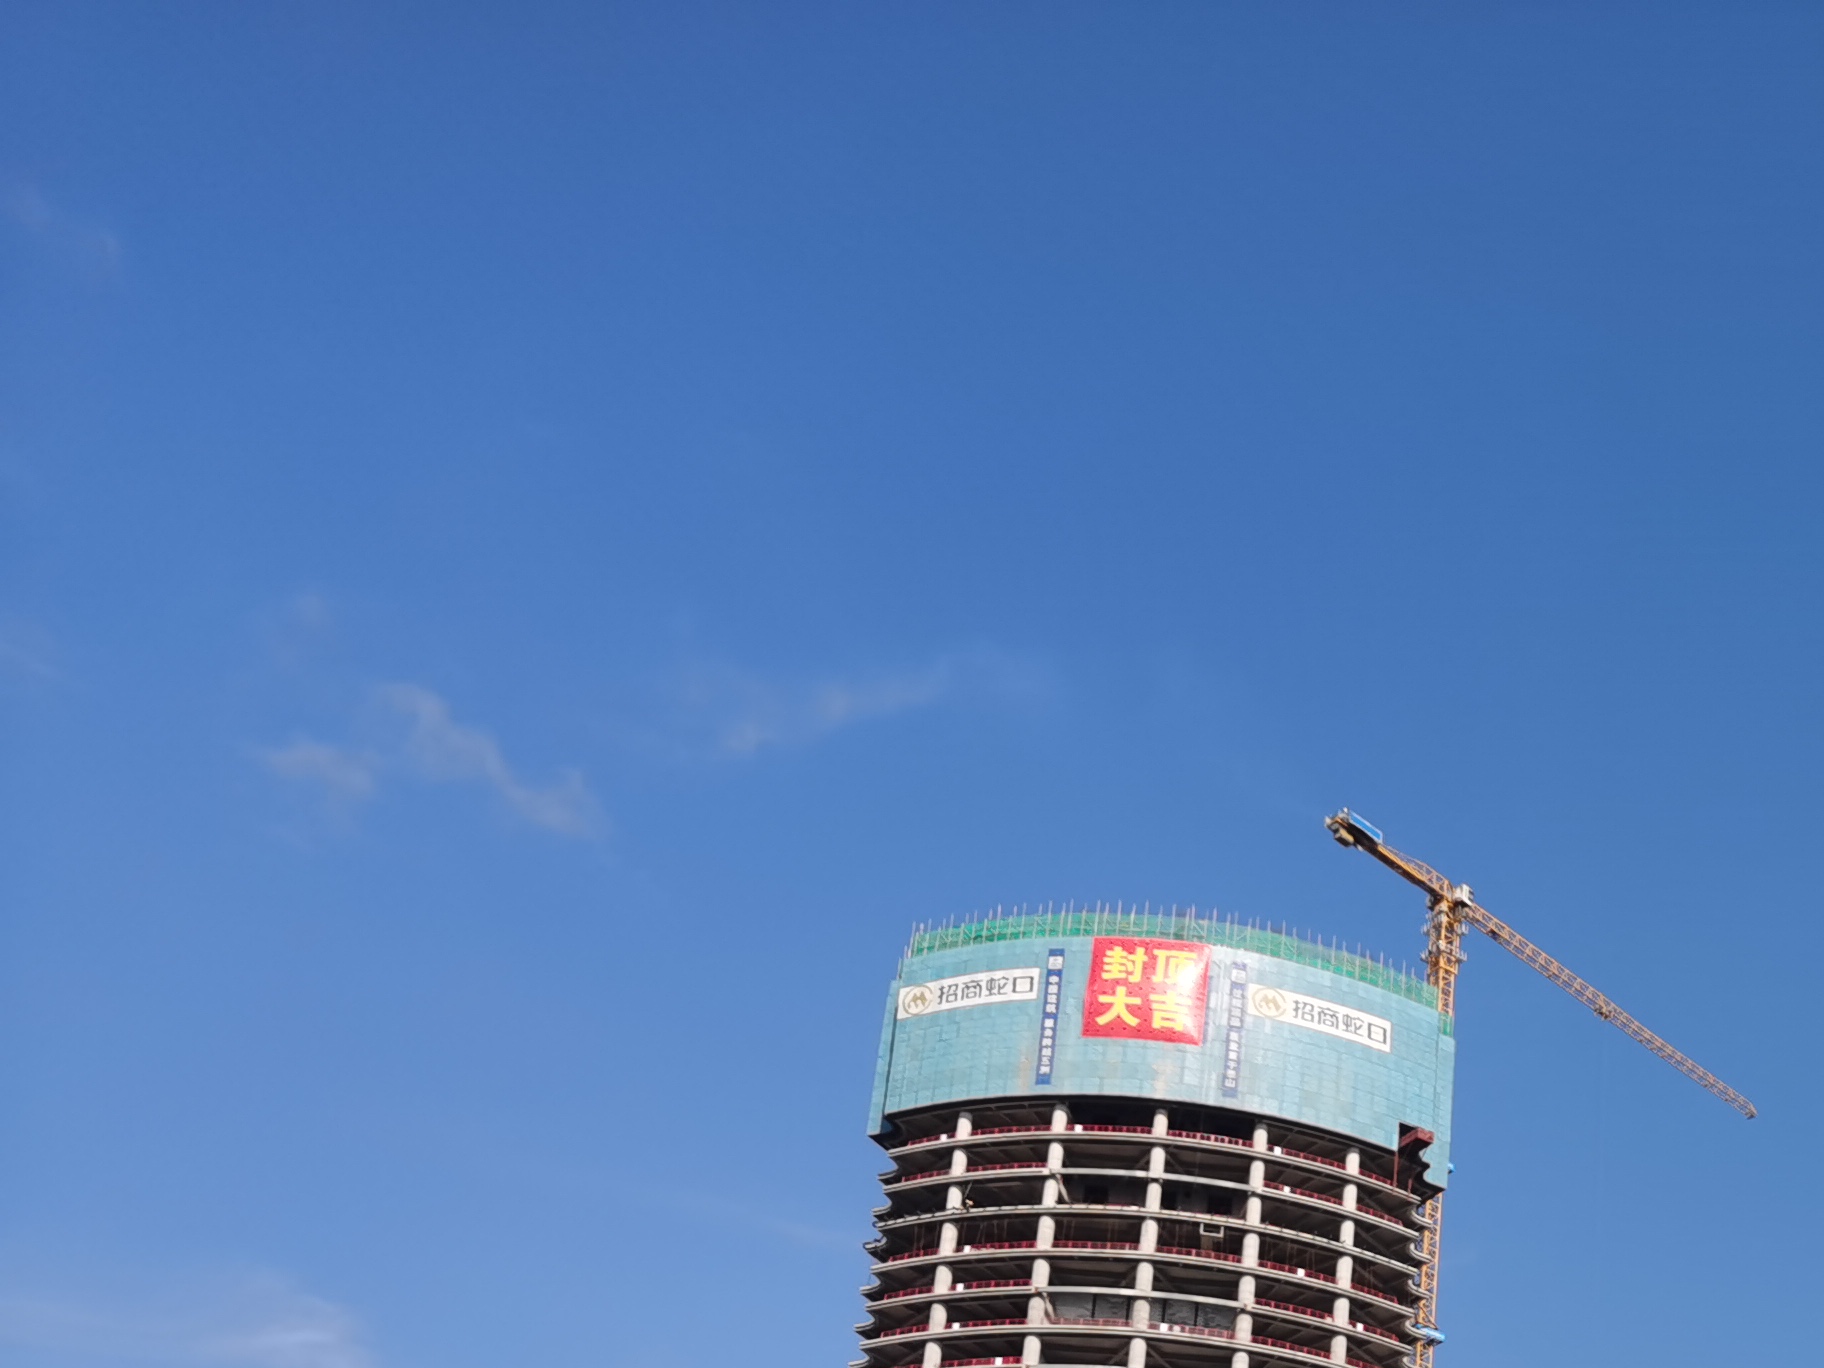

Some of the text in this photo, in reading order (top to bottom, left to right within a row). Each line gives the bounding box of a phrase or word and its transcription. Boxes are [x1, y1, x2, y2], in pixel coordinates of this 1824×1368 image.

[1101, 946, 1200, 985] 封顶
[937, 976, 1035, 1005] 招商蛇口
[1094, 986, 1192, 1032] 大吉
[1292, 1000, 1388, 1045] 招商蛇口
